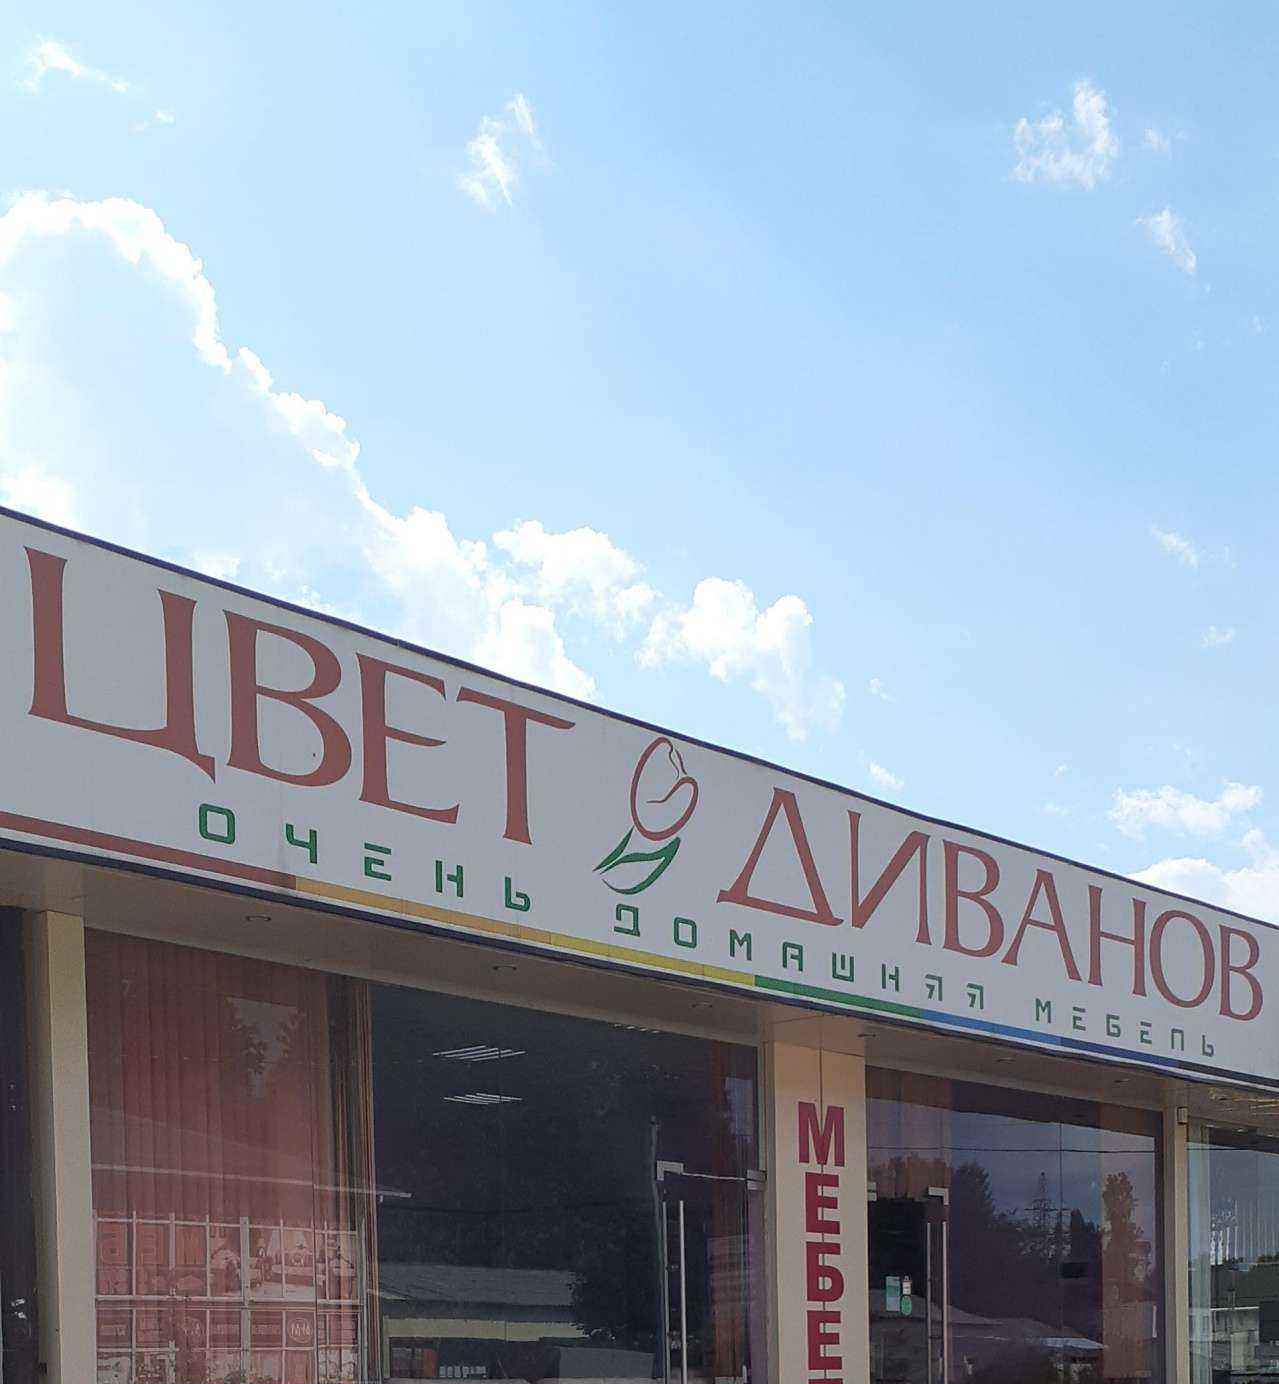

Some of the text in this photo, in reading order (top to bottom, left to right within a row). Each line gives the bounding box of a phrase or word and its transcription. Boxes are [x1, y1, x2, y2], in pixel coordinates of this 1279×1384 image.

[24, 546, 1264, 1021] ЦВЕТ ДИВАНОВ
[198, 803, 1215, 1058] ОЧЕНЬ ДОМАШНЯЯ МЕБЕЛЬ
